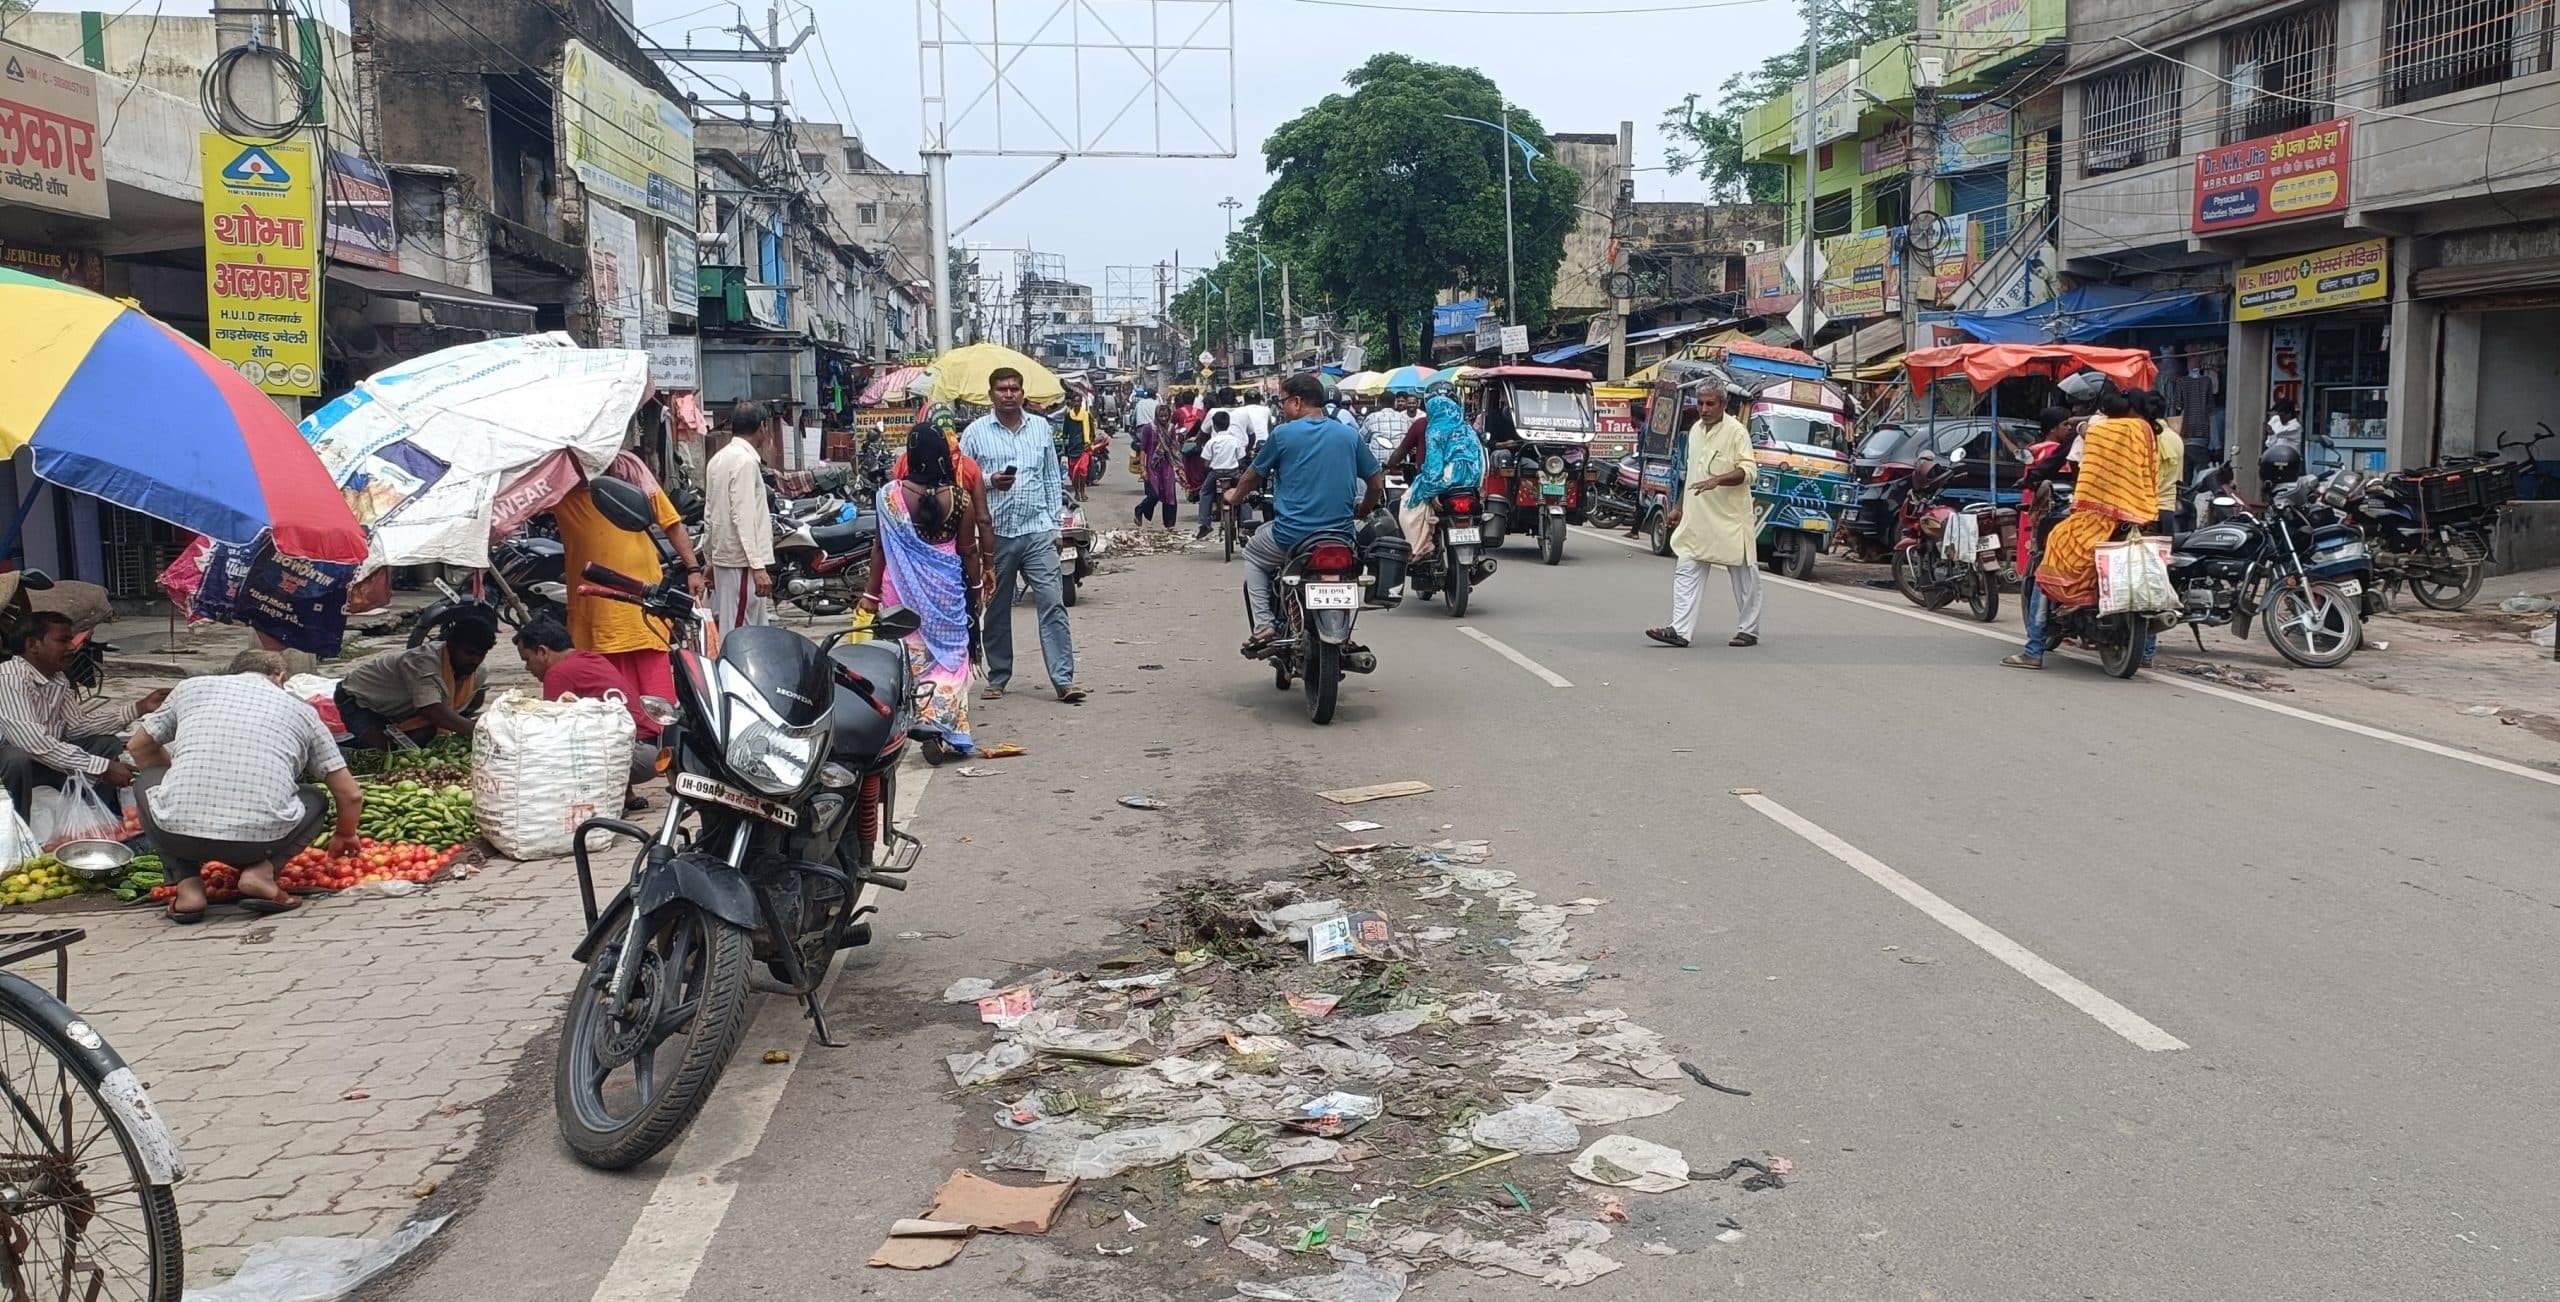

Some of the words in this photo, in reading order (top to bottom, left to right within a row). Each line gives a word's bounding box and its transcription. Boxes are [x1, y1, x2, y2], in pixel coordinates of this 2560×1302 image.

[2324, 131, 2338, 150] झा
[2204, 155, 2218, 176] Dr.
[2221, 151, 2243, 173] N.K.
[2245, 147, 2267, 166] Jha
[213, 203, 304, 249] शोभा
[5, 249, 61, 267] JEWELLERS
[213, 252, 310, 302] अलंकार
[2259, 265, 2298, 288] MEDICO
[221, 310, 255, 322] H.U.I.D
[258, 312, 302, 324] हालमार्क
[272, 329, 307, 344] ज्वेलरी
[252, 346, 273, 359] शॉप
[883, 415, 915, 425] MOBILE
[1312, 597, 1352, 605] 5152
[775, 686, 813, 706] HONDA
